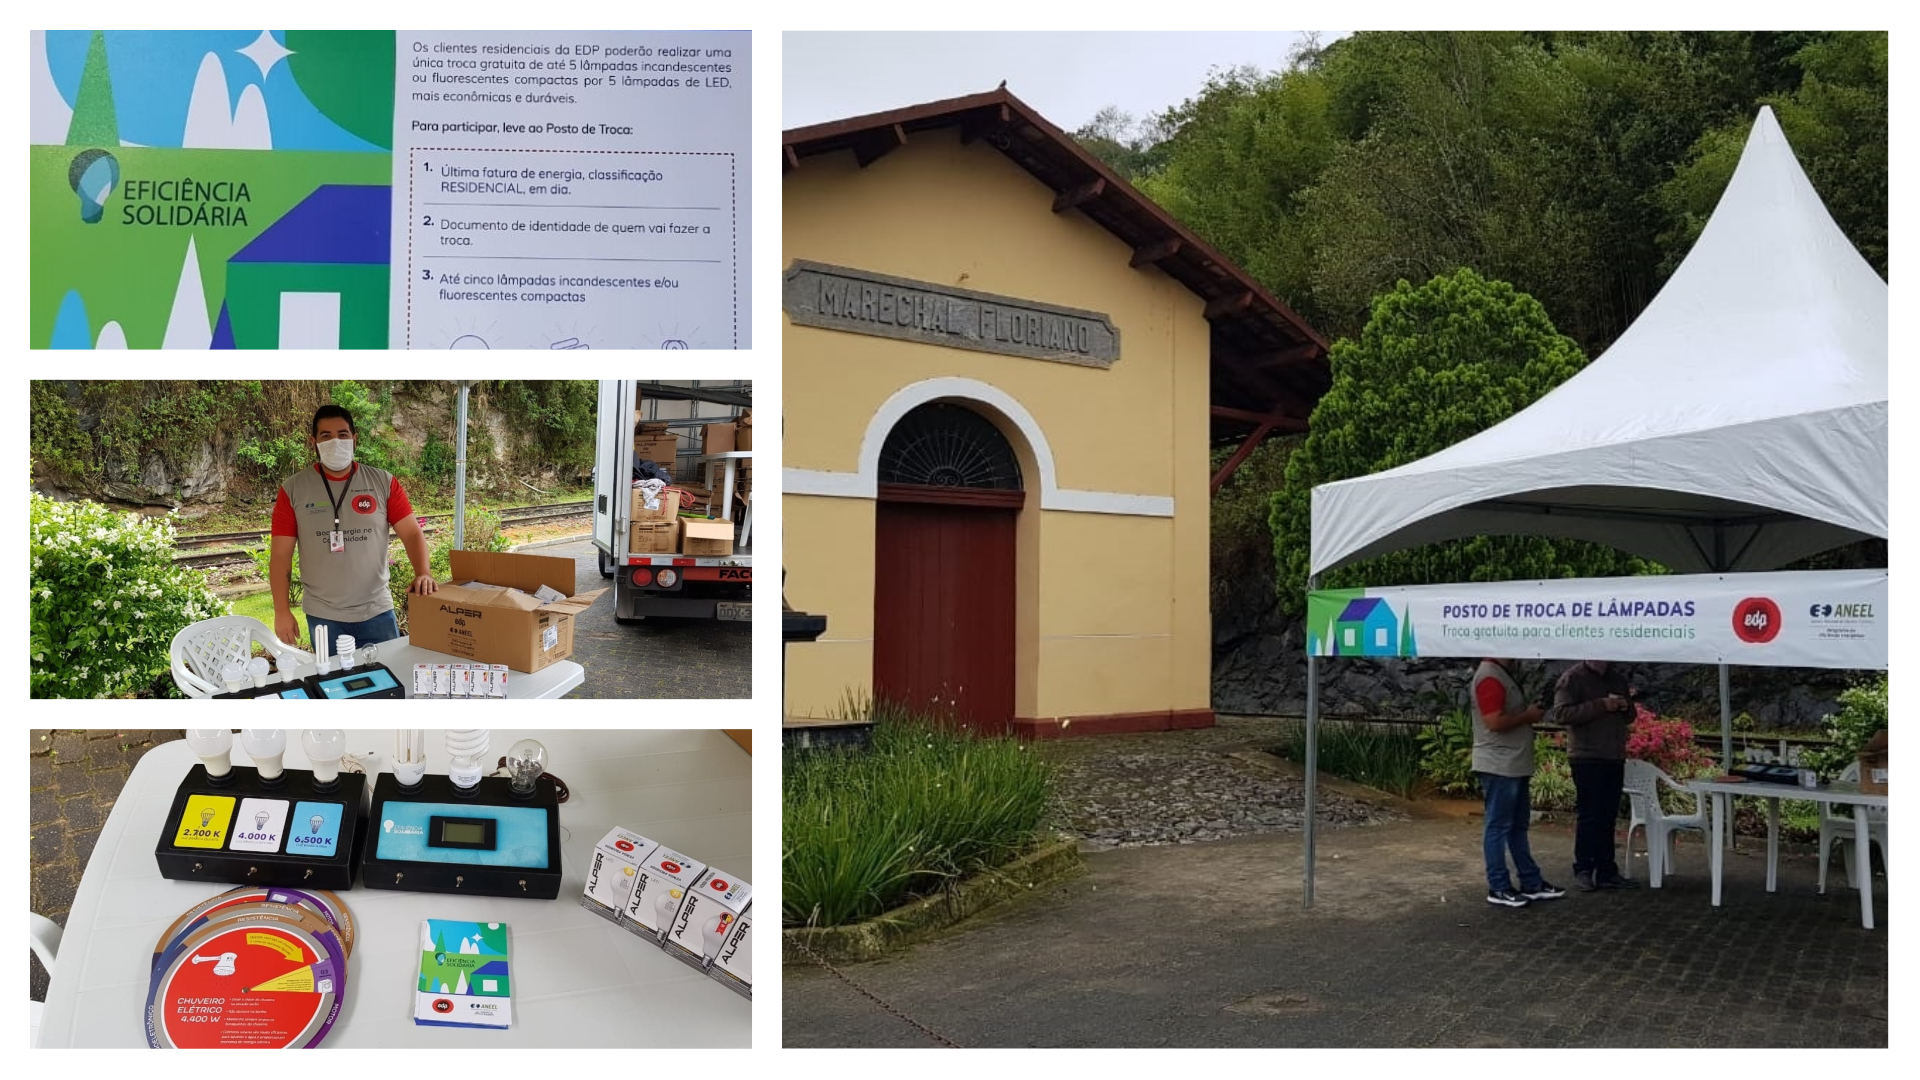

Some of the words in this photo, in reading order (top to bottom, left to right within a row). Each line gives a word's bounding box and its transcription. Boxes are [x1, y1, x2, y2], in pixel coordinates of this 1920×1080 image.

[413, 42, 428, 53] Os
[434, 43, 477, 54] clientes
[482, 44, 550, 56] residenciais
[555, 44, 570, 56] da
[575, 45, 599, 56] EDP
[605, 46, 652, 59] poderão
[658, 46, 701, 58] realizar
[705, 49, 731, 58] uma
[413, 58, 444, 69] única
[447, 59, 477, 69] troca
[480, 59, 526, 71] gratuita
[529, 59, 544, 70] de
[547, 59, 566, 70] até
[569, 60, 577, 71] 5
[580, 60, 638, 74] lâmpadas
[642, 61, 731, 73] incandescentes
[413, 75, 427, 83] ou
[432, 73, 509, 85] fluorescentes
[515, 74, 578, 87] compactas
[584, 77, 602, 88] por
[609, 76, 616, 87] 5
[622, 75, 680, 89] lâmpadas
[685, 77, 700, 88] de
[705, 77, 732, 89] LED,
[412, 91, 439, 101] mais
[443, 91, 512, 103] econômicas
[515, 95, 522, 103] e
[525, 92, 577, 104] duráveis.
[412, 121, 439, 132] Para
[442, 121, 500, 135] participar,
[503, 123, 526, 133] leve
[529, 125, 543, 134] ao
[547, 123, 578, 134] Posto
[582, 124, 596, 134] de
[599, 125, 633, 135] Troca:
[424, 162, 432, 171] 1.
[441, 164, 479, 178] Última
[482, 167, 518, 179] fatura
[521, 168, 536, 179] de
[539, 169, 585, 182] energia,
[588, 169, 663, 183] classificação
[124, 178, 251, 202] EFICIÊNCIA
[441, 182, 526, 194] RESIDENCIAL,
[529, 186, 547, 195] em
[550, 184, 571, 195] dia.
[122, 203, 248, 227] SOLIDÁRIA
[423, 216, 434, 226] 2.
[441, 220, 508, 231] Documento
[511, 221, 526, 232] de
[529, 221, 590, 232] identidade
[594, 222, 609, 233] de
[612, 225, 645, 235] quem
[649, 222, 666, 233] vai
[669, 223, 700, 234] fazer
[702, 226, 710, 234] a
[440, 236, 473, 246] troca.
[422, 270, 434, 280] 3.
[440, 274, 460, 285] Até
[464, 275, 494, 286] cinco
[497, 275, 556, 288] lâmpadas
[559, 276, 650, 288] incandescentes
[654, 277, 679, 288] e/ou
[439, 290, 517, 301] fluorescentes
[521, 292, 586, 304] compactas
[818, 279, 960, 336] MARECHAL
[978, 305, 1091, 354] FLORIANO
[359, 500, 371, 509] edp
[719, 570, 752, 579] FAC
[440, 605, 482, 619] ALPER
[1443, 604, 1488, 619] POSTO
[1493, 604, 1510, 618] DE
[1516, 603, 1566, 618] TROCA
[1572, 602, 1592, 617] DE
[1598, 598, 1695, 617] LÂMPADAS
[1834, 604, 1874, 618] ANEEL
[455, 618, 466, 628] edp
[1744, 610, 1767, 630] edp
[1442, 624, 1470, 638] Troca
[1473, 624, 1518, 641] gratuita
[1523, 626, 1550, 640] para
[1555, 624, 1604, 638] clientes
[1609, 624, 1695, 639] residenciais
[183, 829, 211, 837] 2.700
[238, 833, 266, 841] 4.000
[294, 836, 322, 844] 6.500
[588, 853, 604, 894] ALPER
[630, 873, 650, 915] ALPER
[261, 903, 299, 915] RESISTÊNCIA
[675, 895, 699, 939] ALPER
[722, 922, 750, 965] ALPER
[177, 1005, 223, 1014] ELÉTRICO
[326, 1003, 339, 1025] MOTOR
